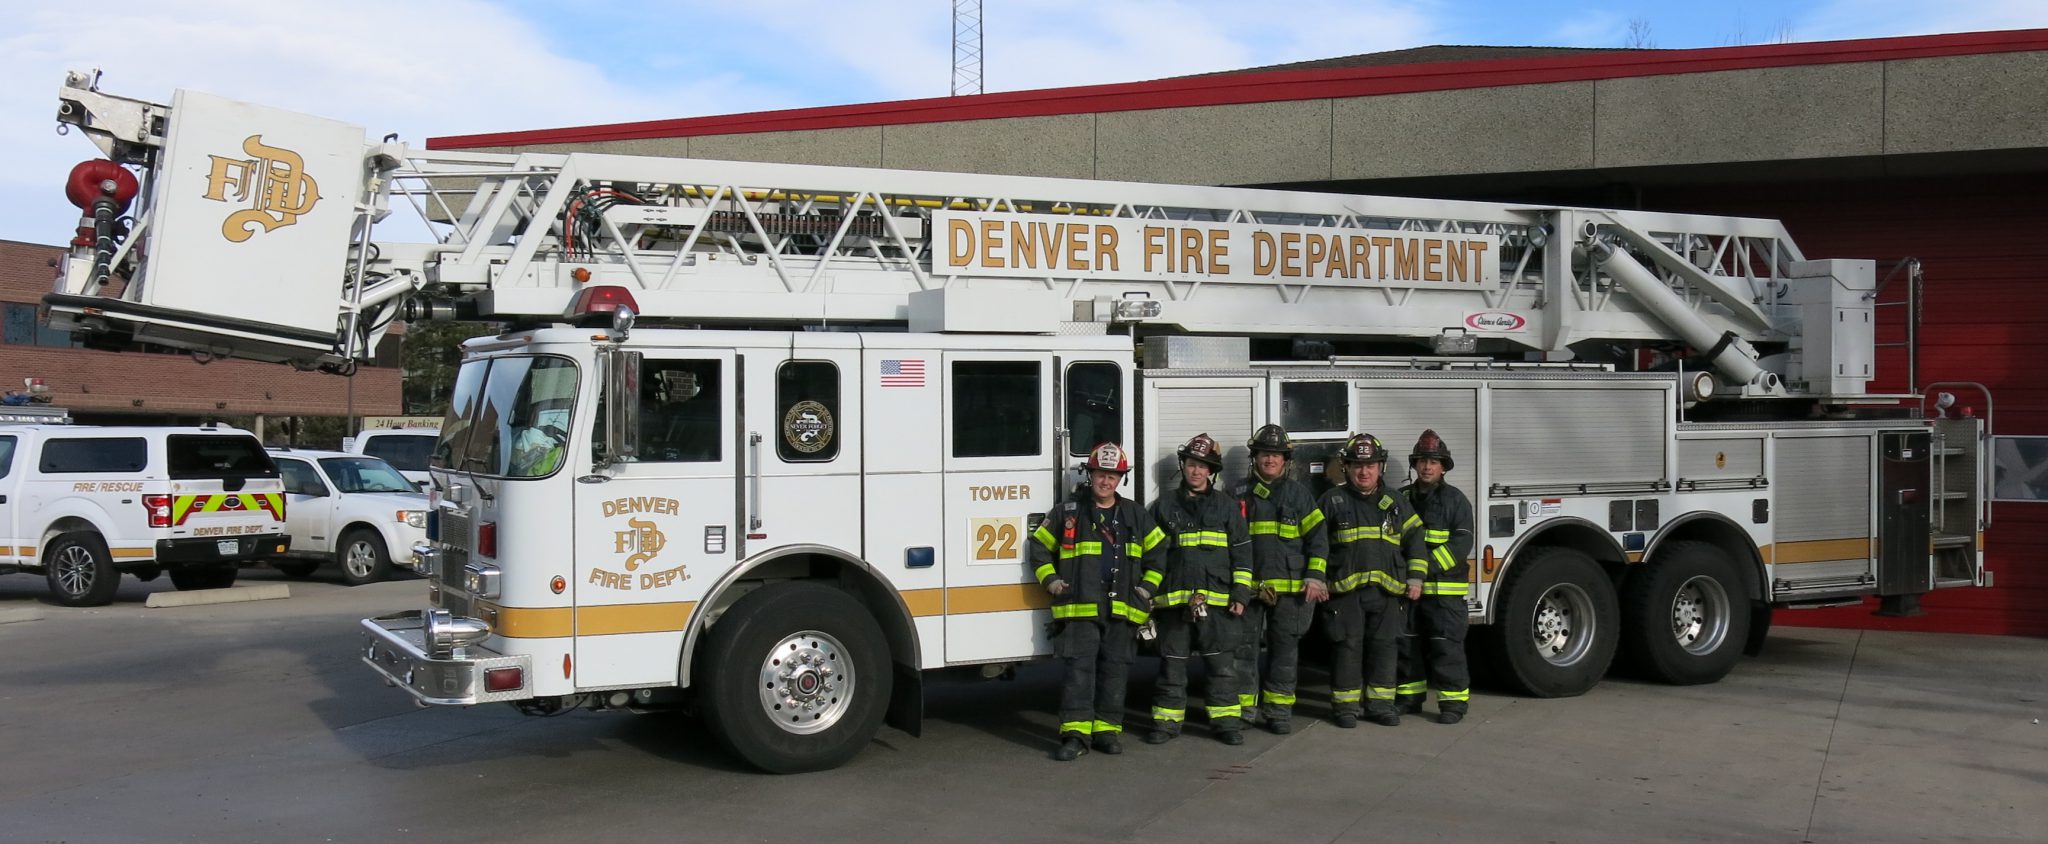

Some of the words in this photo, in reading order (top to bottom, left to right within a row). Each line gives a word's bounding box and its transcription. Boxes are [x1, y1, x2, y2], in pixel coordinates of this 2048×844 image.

[948, 218, 1119, 272] DENVER
[1144, 226, 1230, 275] FIRE
[1253, 231, 1488, 283] DEPARTMENT
[375, 419, 385, 428] 24
[386, 419, 406, 428] Hour
[407, 419, 439, 429] Banking
[1193, 442, 1207, 452] 22
[1358, 445, 1370, 454] 22
[1102, 450, 1117, 461] 22
[72, 482, 144, 492] FIRE/RESCUE
[969, 485, 1031, 501] TOWER
[602, 497, 679, 518] DENVER
[193, 527, 224, 536] DENVER
[226, 526, 242, 534] FIRE
[245, 525, 263, 533] DEPT.
[976, 523, 1017, 560] 22
[589, 568, 632, 590] FIRE
[640, 565, 691, 590] DEPT.
